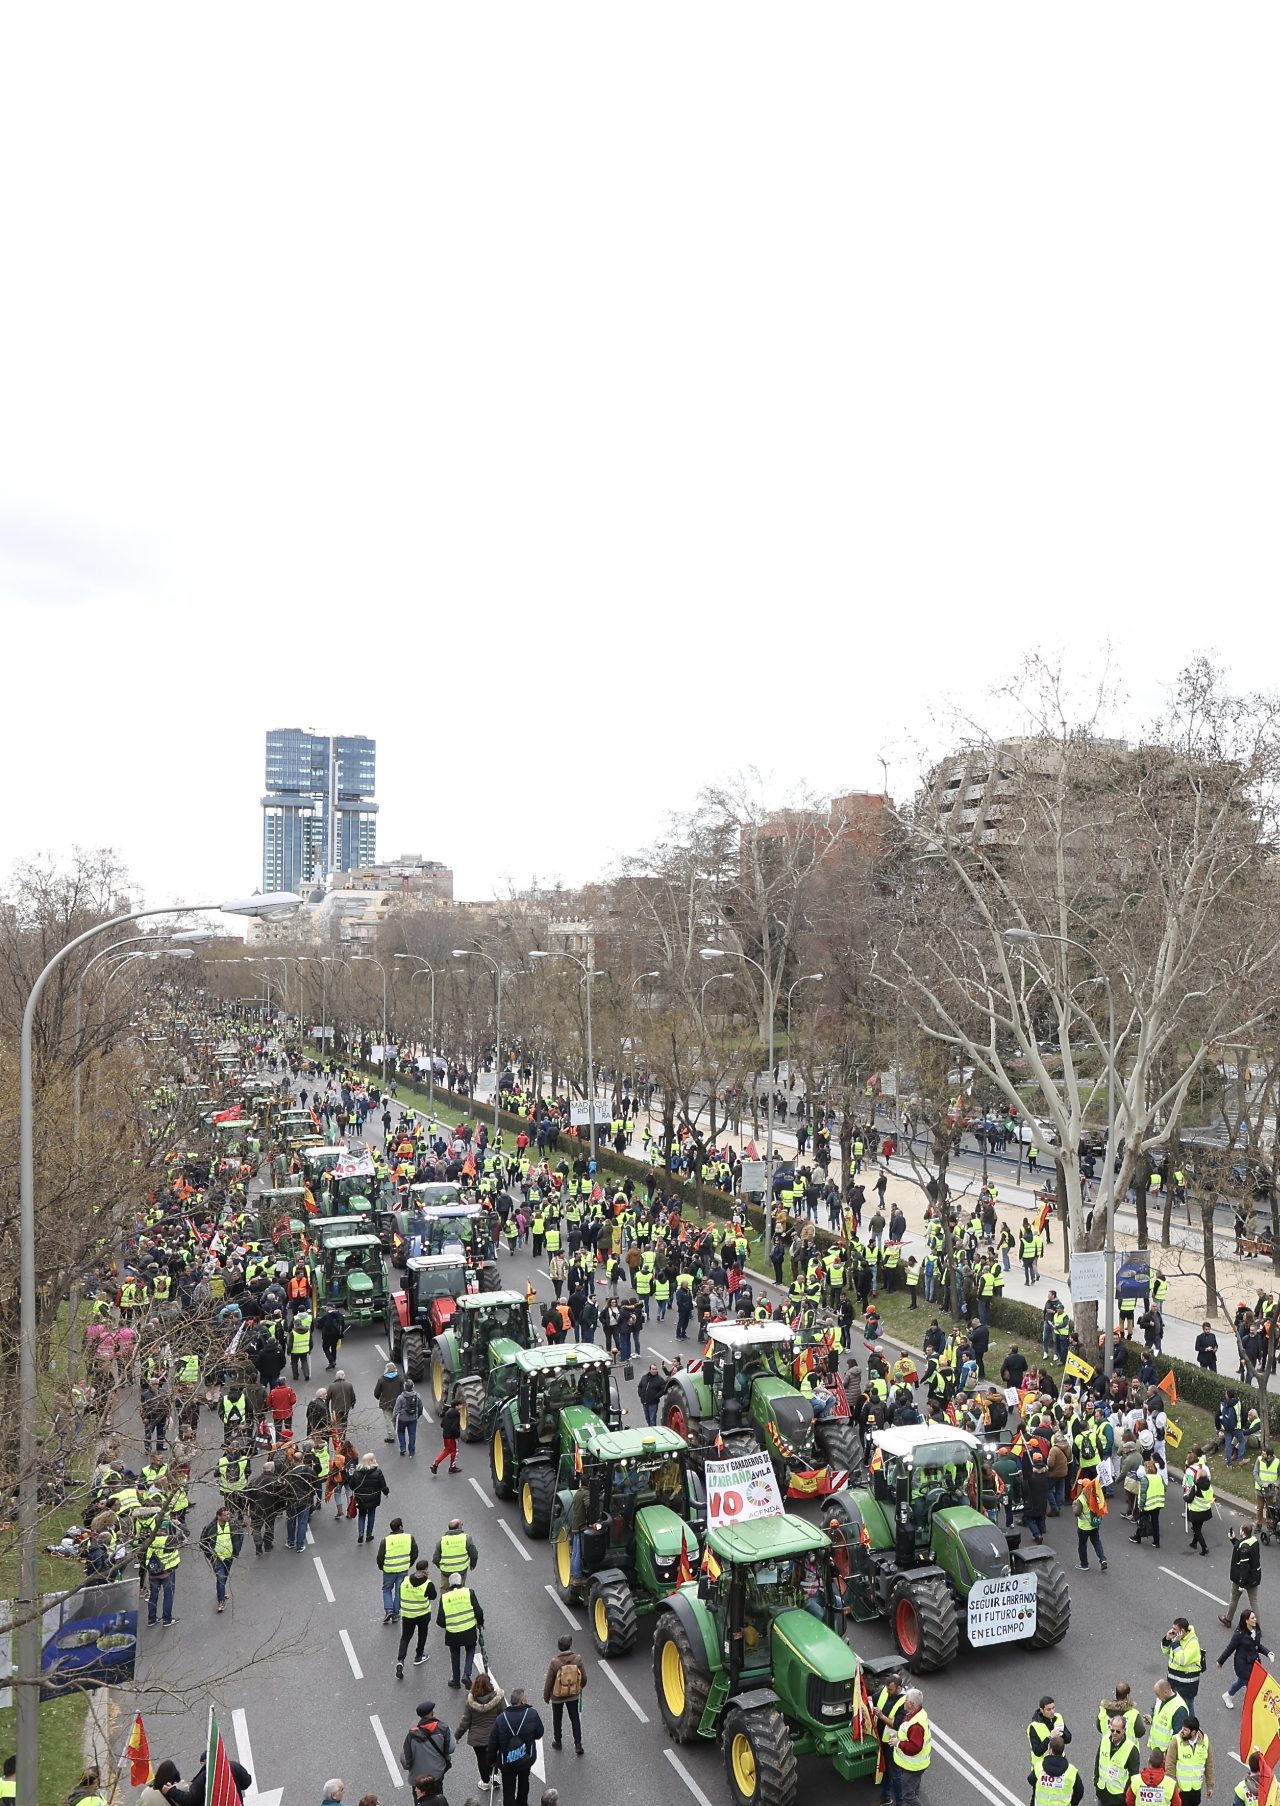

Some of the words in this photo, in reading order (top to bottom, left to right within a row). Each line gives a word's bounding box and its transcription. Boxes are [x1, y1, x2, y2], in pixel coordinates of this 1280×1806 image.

[748, 1505, 781, 1519] AGENDA
[983, 1579, 1019, 1596] QUIERO
[969, 1596, 1001, 1610] SEGUIR
[1002, 1592, 1038, 1606] LABRANDO
[970, 1613, 982, 1625] MI
[985, 1608, 1018, 1622] FUTURO
[506, 1743, 527, 1763] NIKE
[1041, 1775, 1055, 1783] NO
[1140, 1791, 1154, 1799] NO
